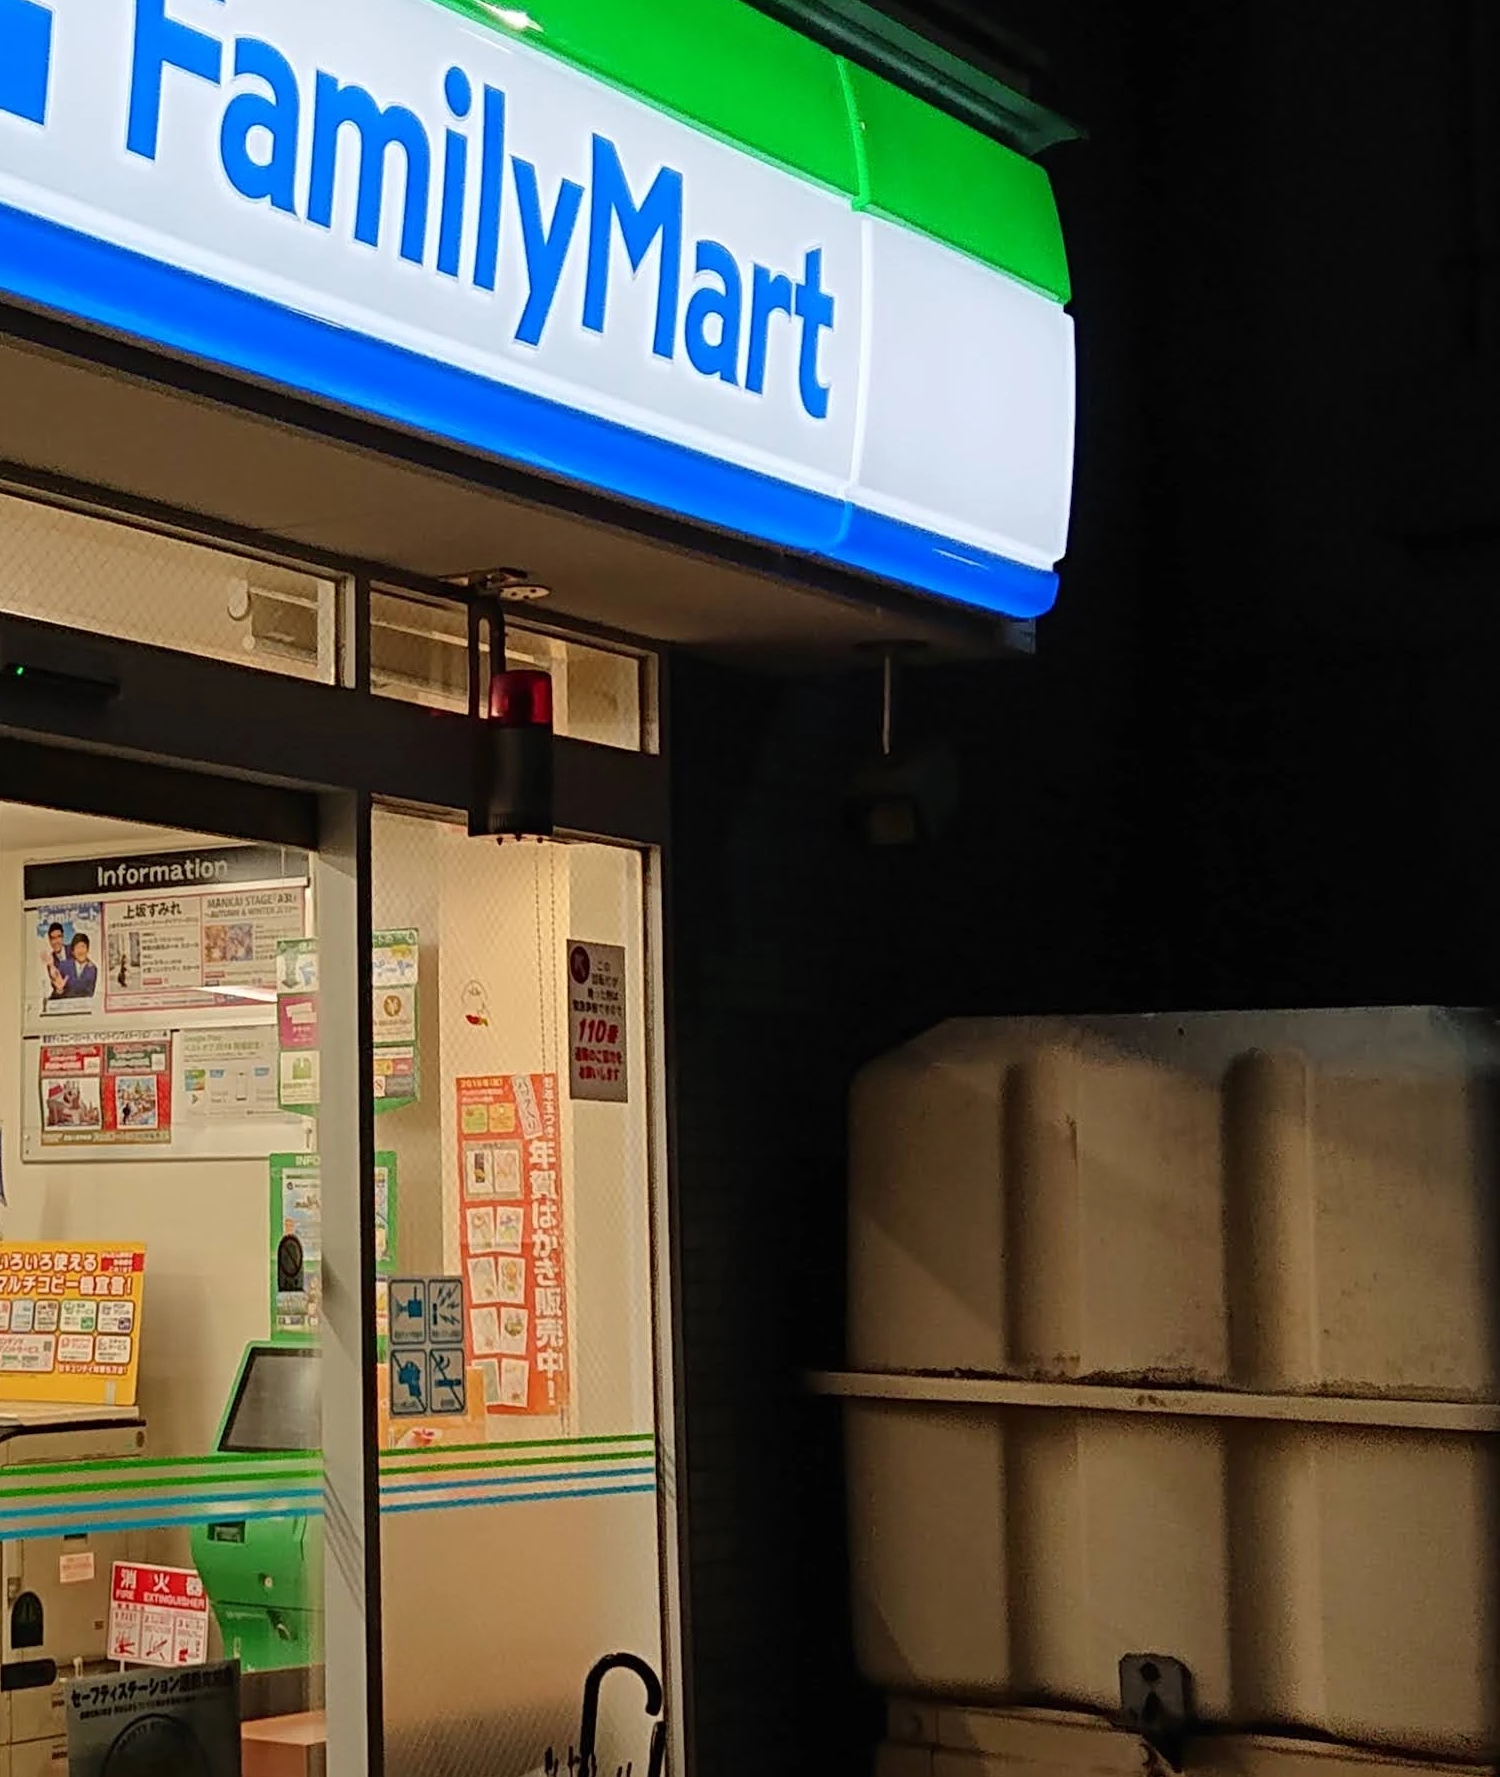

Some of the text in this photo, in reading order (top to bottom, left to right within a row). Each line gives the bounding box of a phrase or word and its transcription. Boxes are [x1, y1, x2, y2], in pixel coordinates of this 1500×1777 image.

[97, 857, 228, 887] Information
[123, 900, 182, 920] 上坂すみれ
[579, 1018, 619, 1044] 110番
[529, 1139, 565, 1408] 年賀はがき販売中!
[120, 1568, 204, 1597] 消火器
[115, 1589, 136, 1601] FIRE
[143, 1592, 206, 1610] EXTINGUISHER
